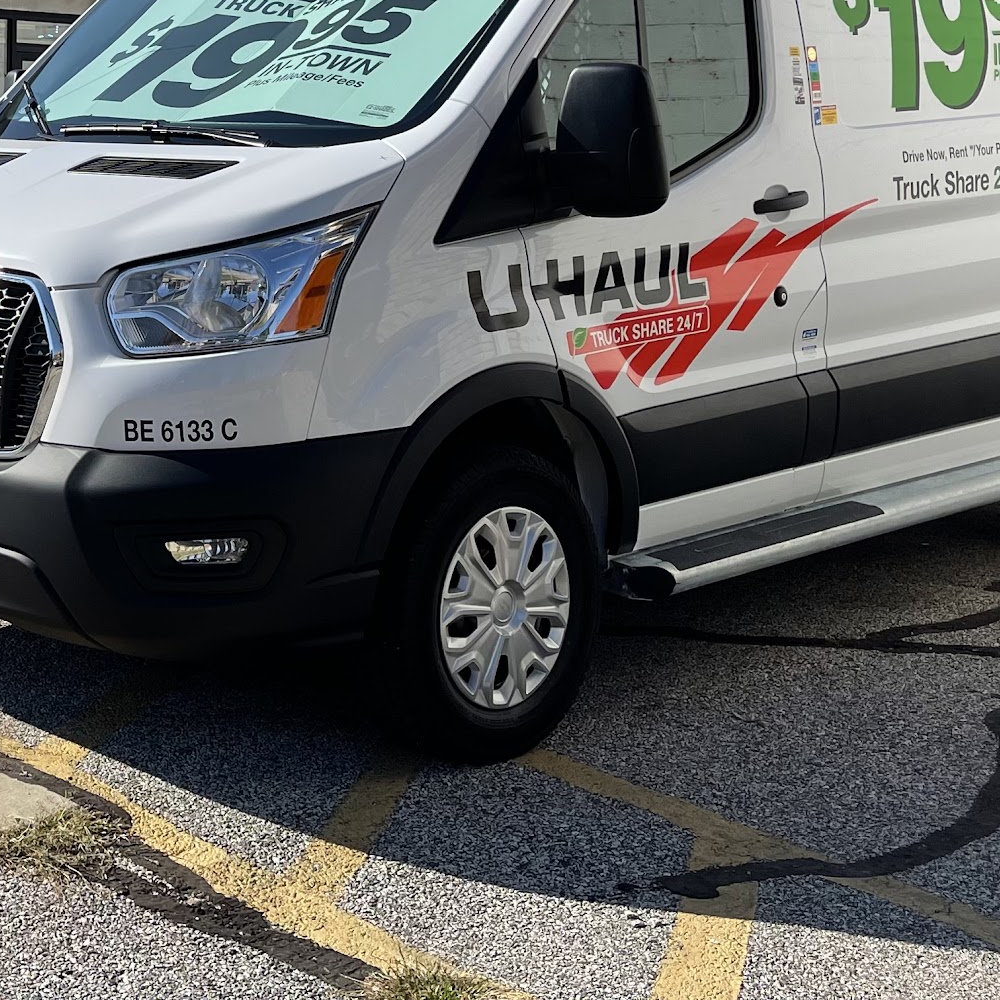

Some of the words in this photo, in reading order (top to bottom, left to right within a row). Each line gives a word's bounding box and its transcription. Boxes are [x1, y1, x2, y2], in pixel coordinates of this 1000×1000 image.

[257, 52, 385, 76] IN-TOWN
[272, 71, 365, 89] Mileage/Fees
[902, 149, 925, 163] Drive
[926, 148, 948, 162] Now,
[949, 145, 969, 159] Rent
[892, 172, 941, 201] Truck
[945, 170, 990, 196] Share
[466, 241, 708, 333] U-HAUL
[590, 325, 630, 348] TRUCK
[632, 316, 675, 340] SHARE
[676, 311, 704, 332] 24/7
[124, 419, 155, 442] BE
[161, 419, 214, 443] 6133
[221, 418, 238, 441] C
